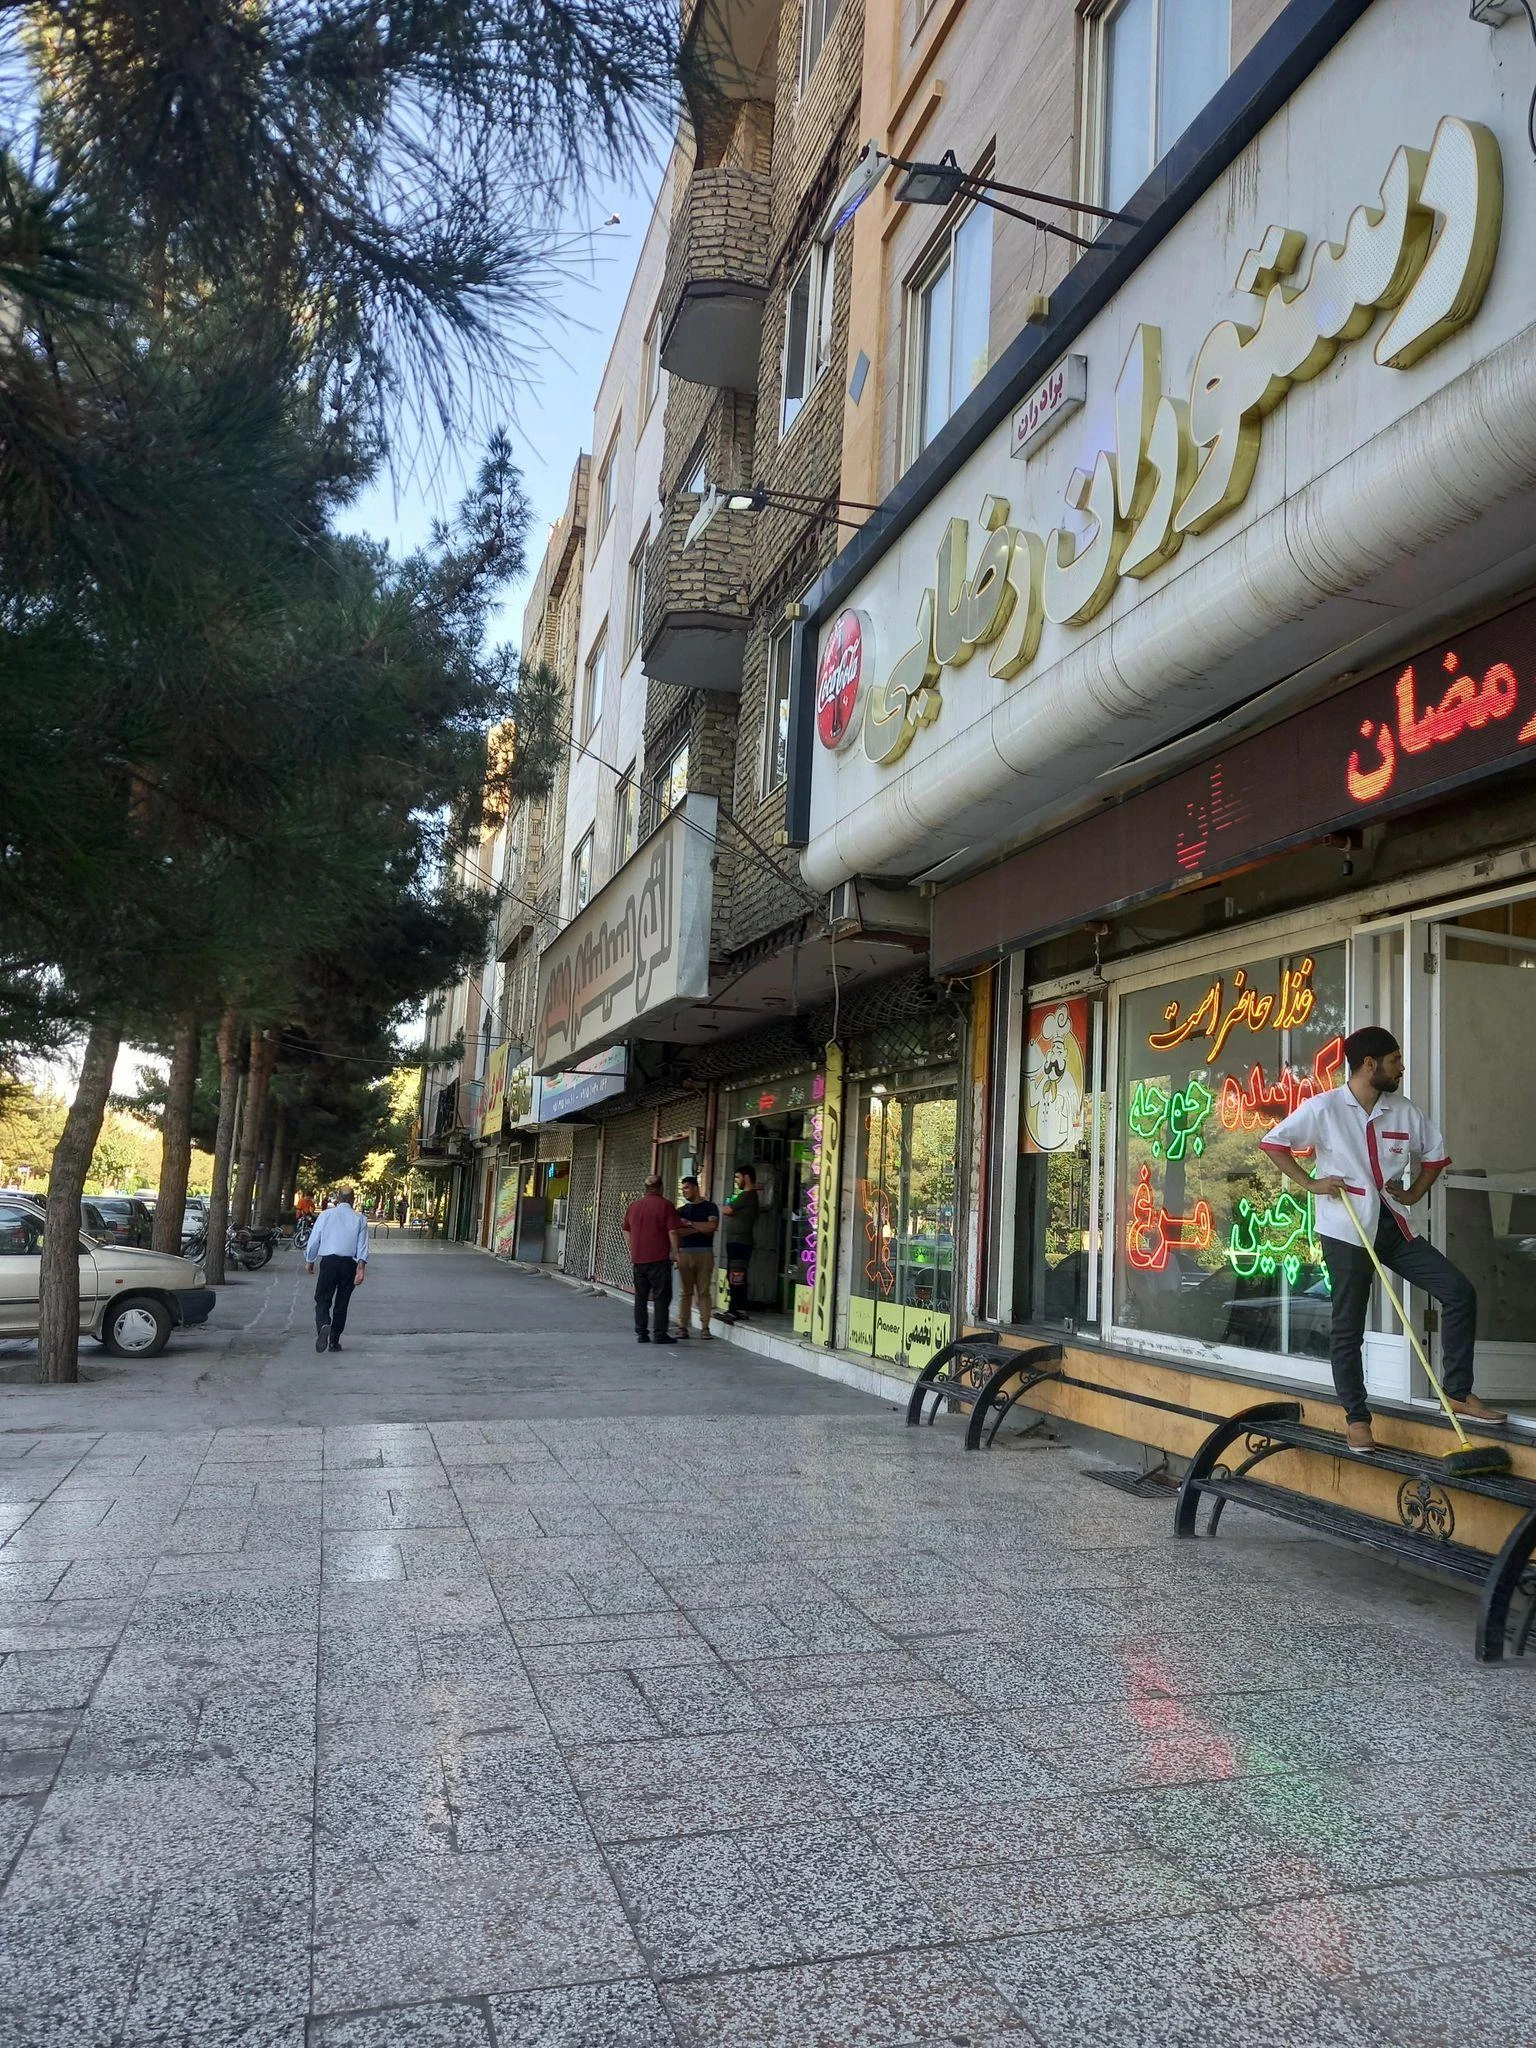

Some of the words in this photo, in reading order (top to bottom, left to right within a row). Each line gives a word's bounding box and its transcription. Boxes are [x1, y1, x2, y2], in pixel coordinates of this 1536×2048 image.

[1017, 372, 1064, 440] برادران
[1042, 114, 1501, 625] رستوران
[863, 493, 1045, 764] رضایی
[1149, 979, 1225, 1050] است
[1206, 967, 1276, 1064] حاضر
[1272, 955, 1317, 1029] غذا
[1129, 1080, 1213, 1160] جوجه
[1128, 1163, 1213, 1270] مرغ
[877, 1317, 900, 1334] Pioneer
